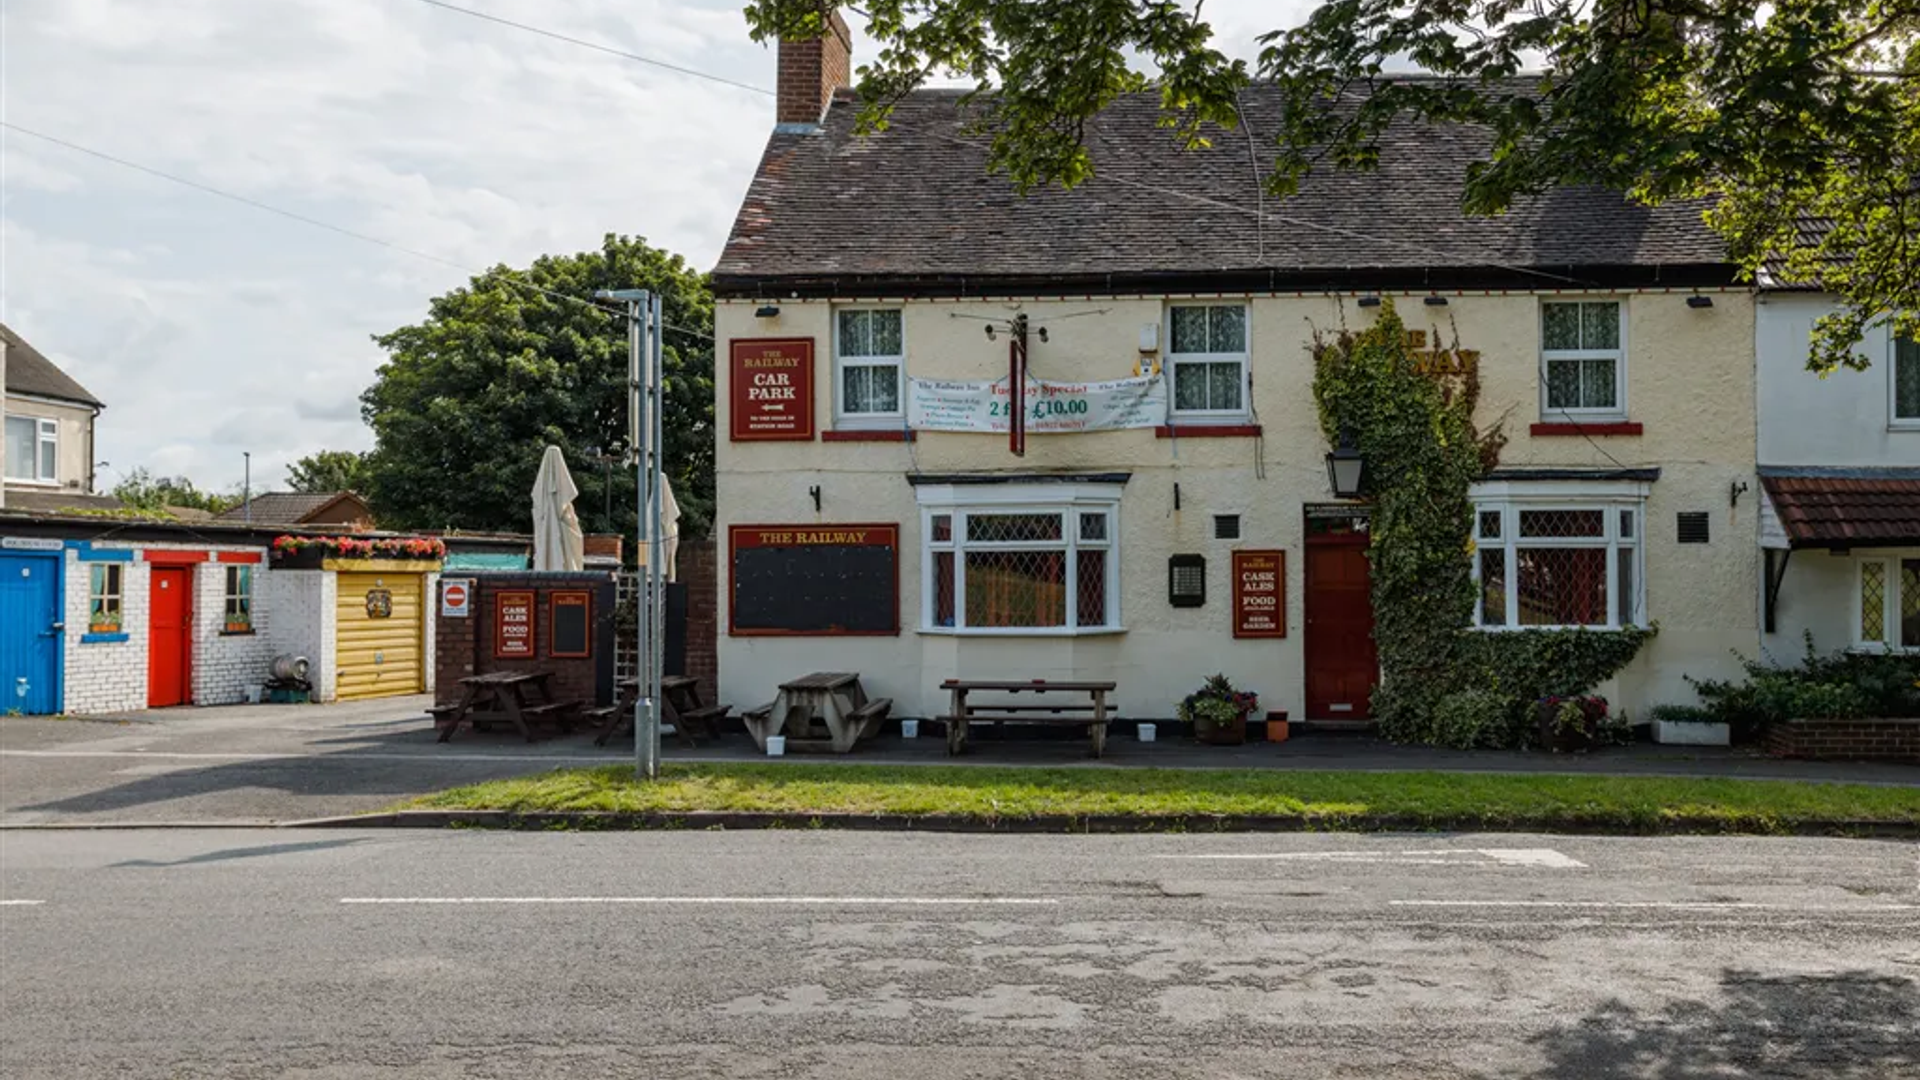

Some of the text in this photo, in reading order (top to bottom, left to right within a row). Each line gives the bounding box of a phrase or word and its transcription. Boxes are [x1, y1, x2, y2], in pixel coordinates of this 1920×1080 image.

[743, 358, 800, 368] RAILWAY
[754, 373, 790, 385] CAR
[748, 386, 796, 400] PARK
[1040, 383, 1087, 396] Special
[990, 401, 999, 416] 2
[1032, 399, 1088, 419] £10.00
[760, 532, 867, 544] THE RAILWAY
[1243, 571, 1275, 581] CASK
[1243, 582, 1274, 591] ALES
[1243, 596, 1276, 605] FOOD
